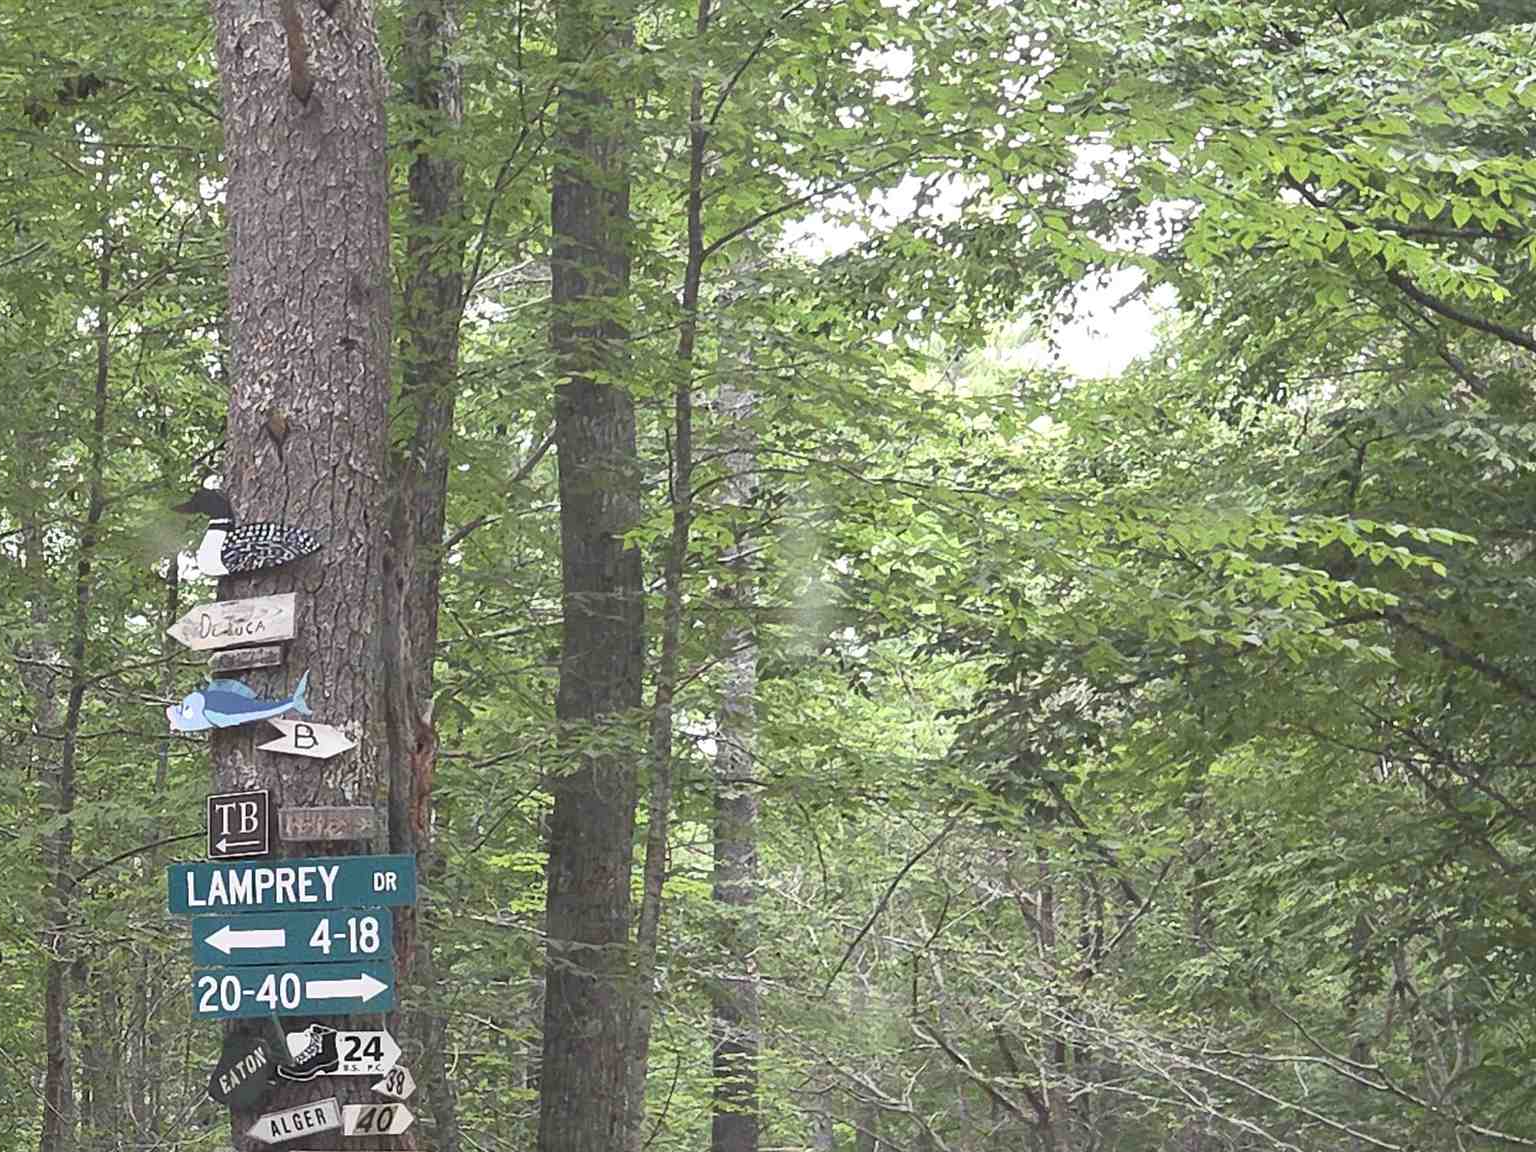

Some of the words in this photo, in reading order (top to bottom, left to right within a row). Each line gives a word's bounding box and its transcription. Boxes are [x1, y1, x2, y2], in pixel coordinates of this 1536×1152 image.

[215, 801, 259, 835] TB
[186, 865, 340, 907] LAMPREY
[373, 871, 398, 892] DR
[309, 916, 381, 954] 4-18
[197, 972, 301, 1013] 20-40
[343, 1035, 385, 1062] 24
[218, 1046, 267, 1095] EATON
[385, 1068, 405, 1095] 38
[270, 1107, 327, 1137] ALGER
[355, 1106, 394, 1133] 40
